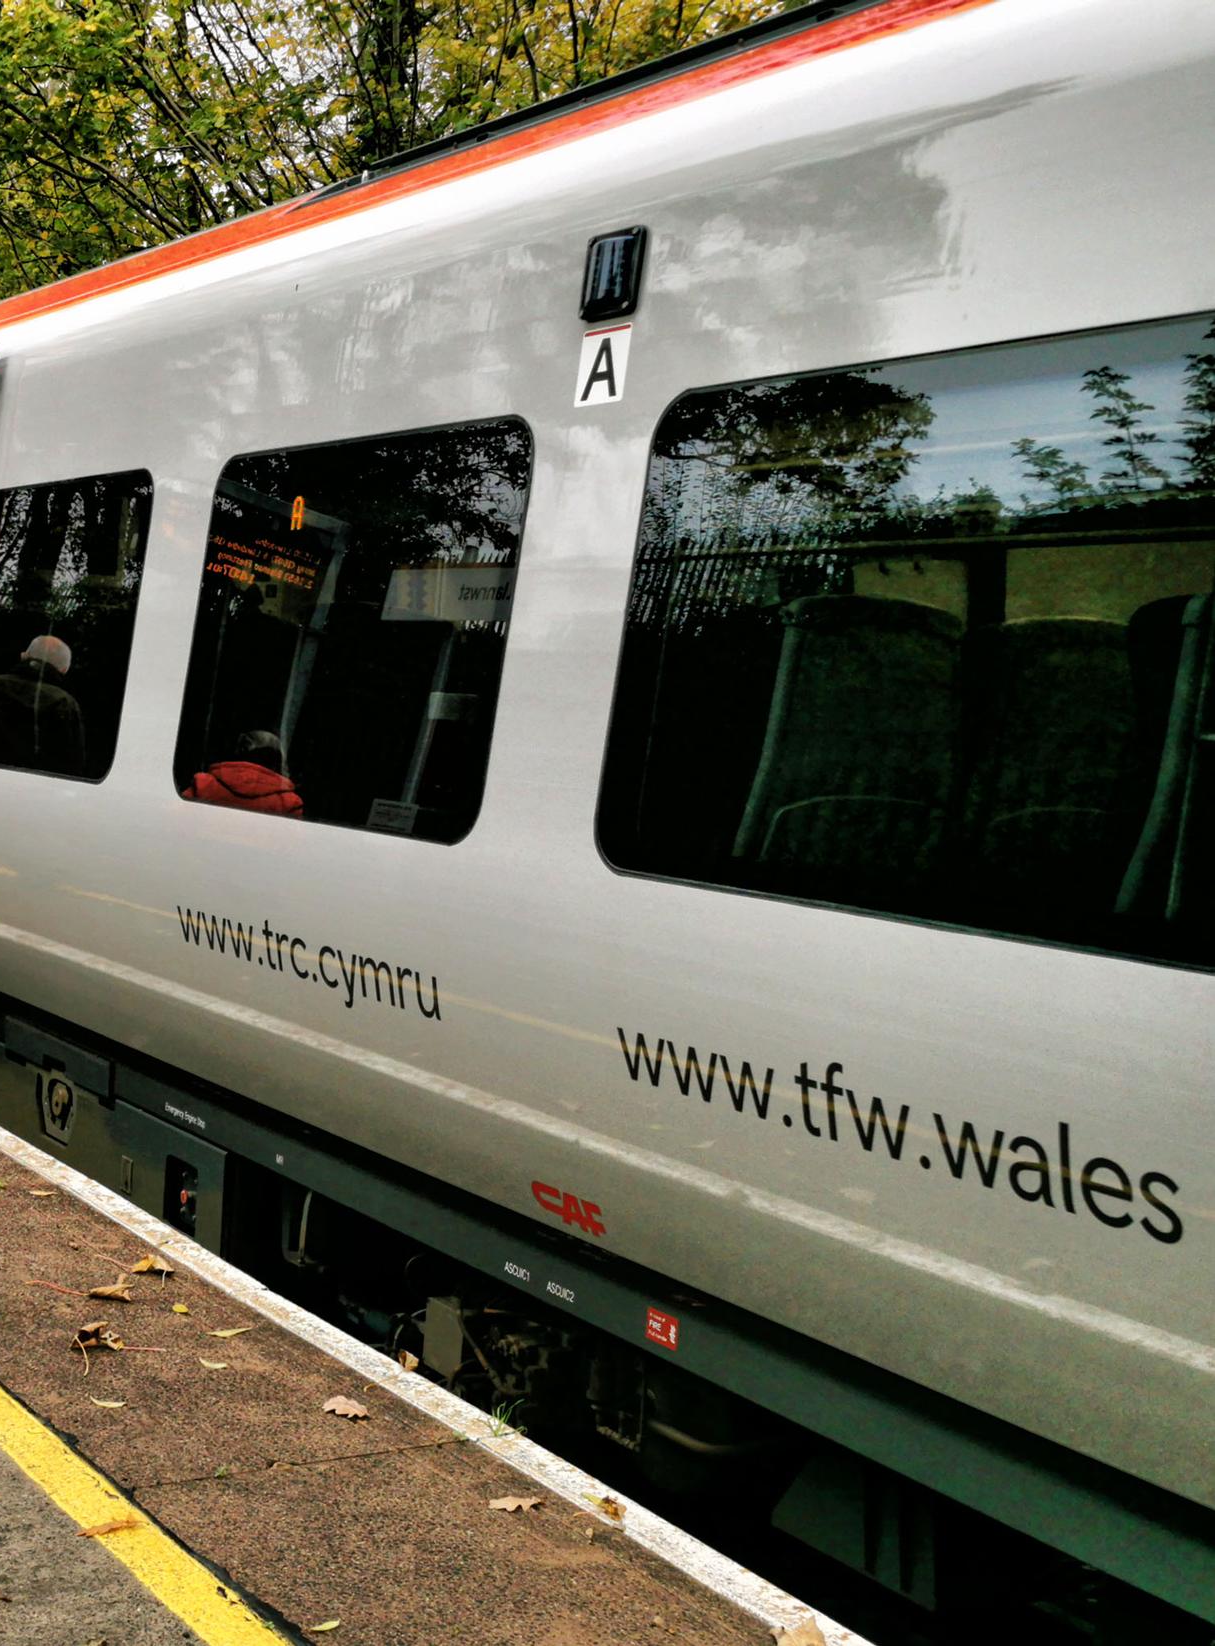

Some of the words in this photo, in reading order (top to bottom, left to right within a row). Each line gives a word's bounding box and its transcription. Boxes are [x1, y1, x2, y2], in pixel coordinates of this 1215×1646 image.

[580, 337, 617, 402] A
[177, 905, 442, 1021] www.trc.cymru
[616, 1026, 1184, 1246] www.tfw.wales
[531, 1181, 607, 1237] CAF
[649, 1319, 662, 1332] FIRE
